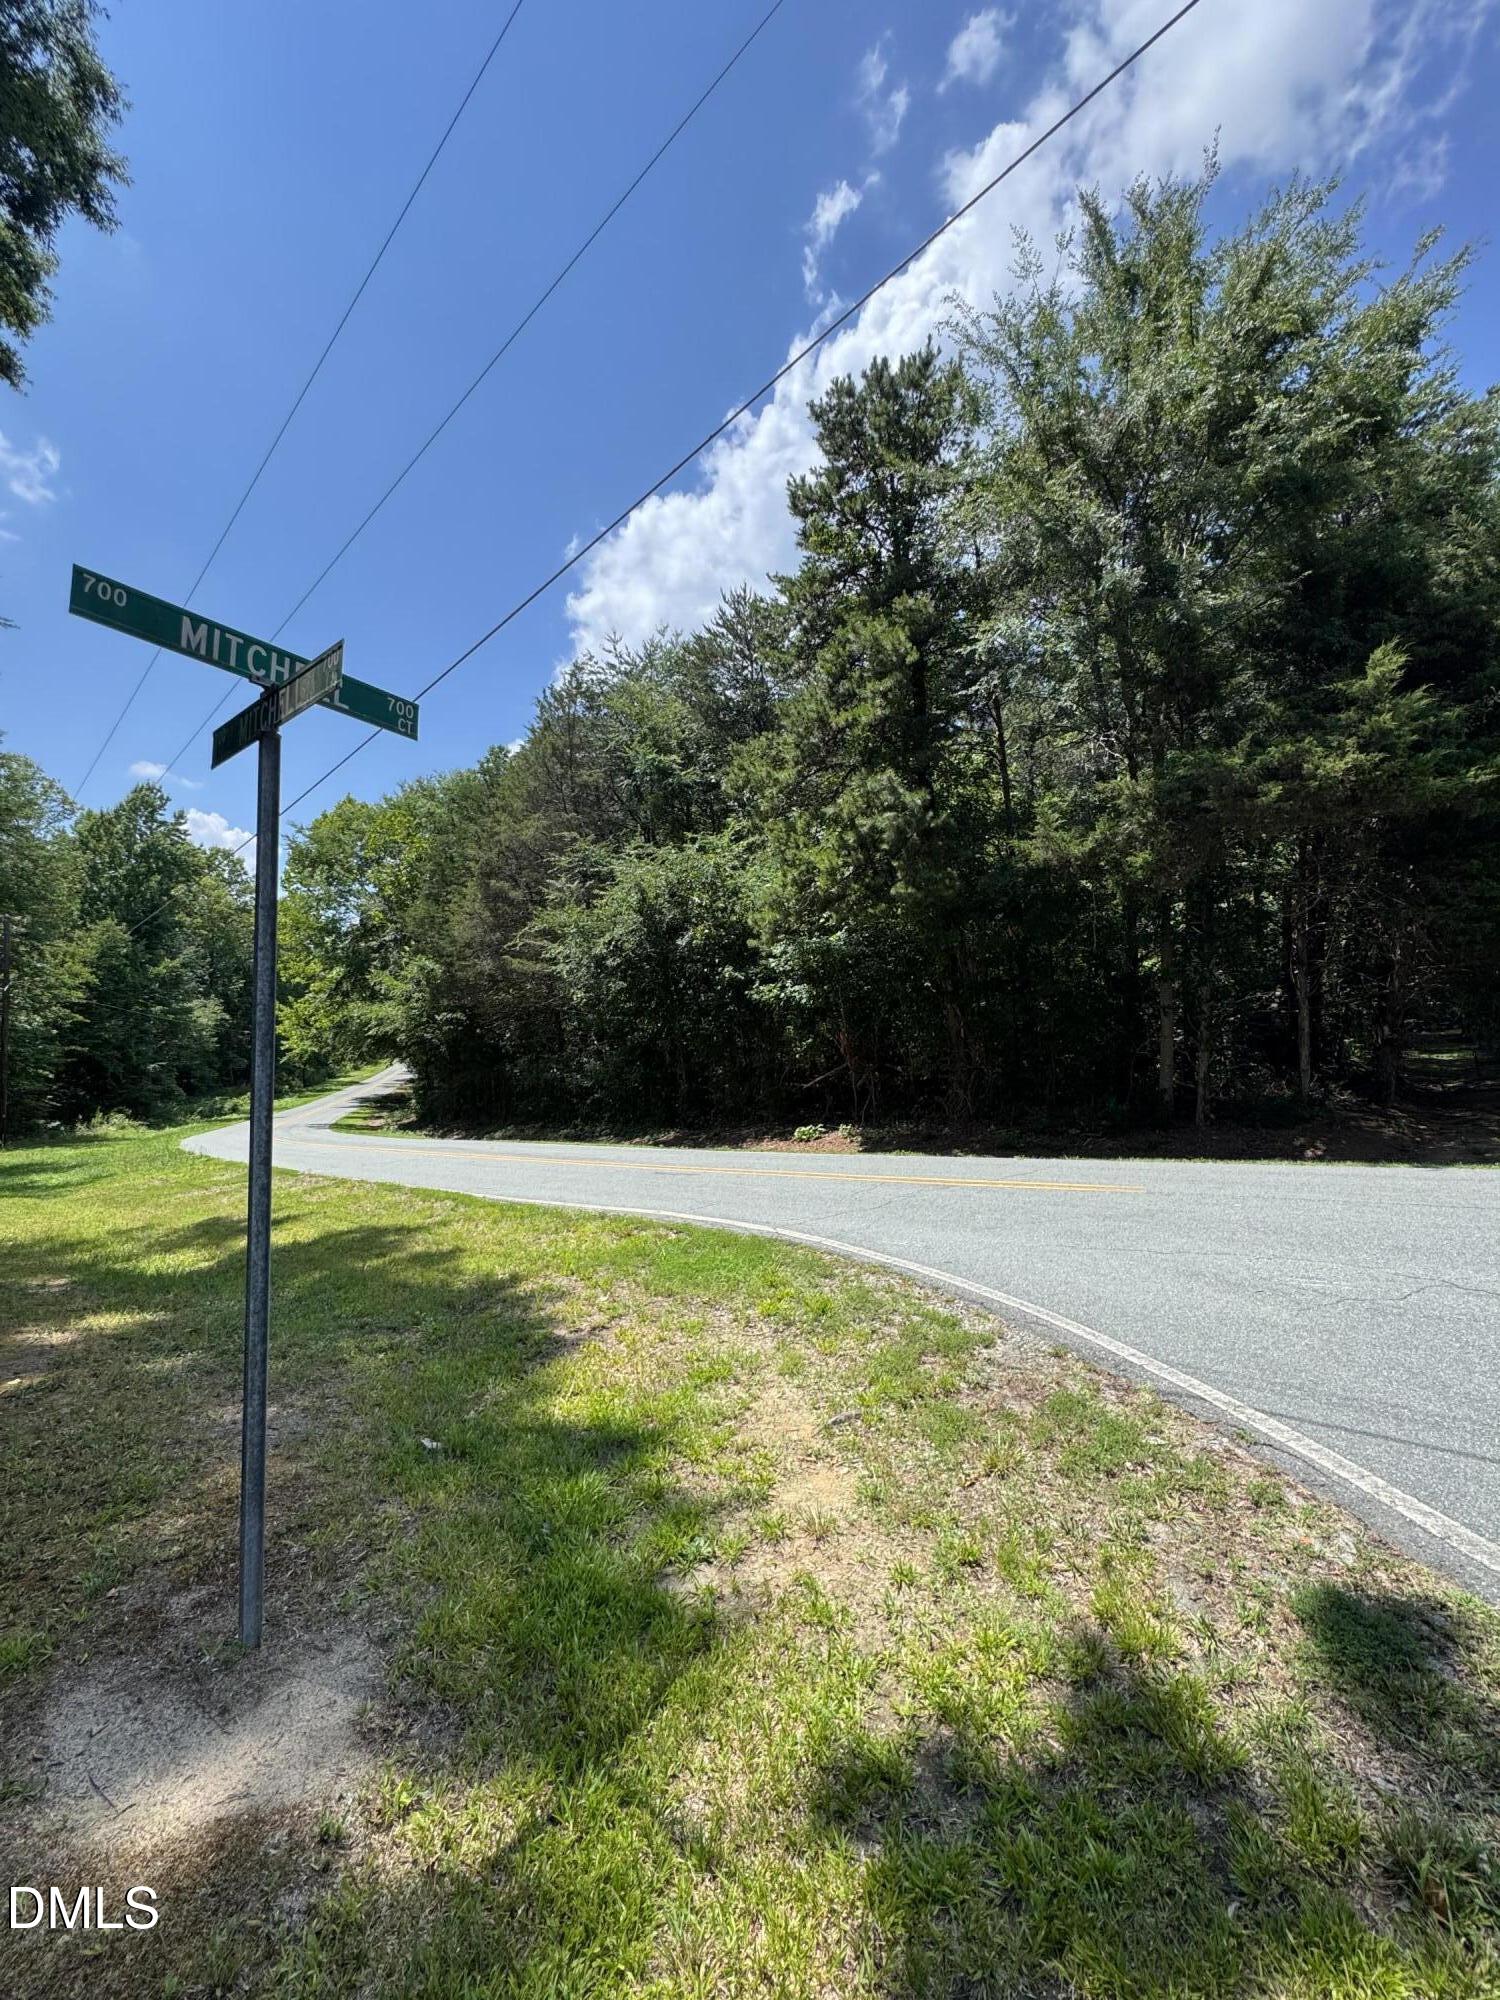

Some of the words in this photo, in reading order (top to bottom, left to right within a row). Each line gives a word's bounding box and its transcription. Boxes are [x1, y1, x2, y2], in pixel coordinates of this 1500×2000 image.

[82, 573, 127, 607] 700
[180, 615, 349, 709] MITCHL
[387, 697, 414, 719] 700
[398, 718, 413, 735] CT
